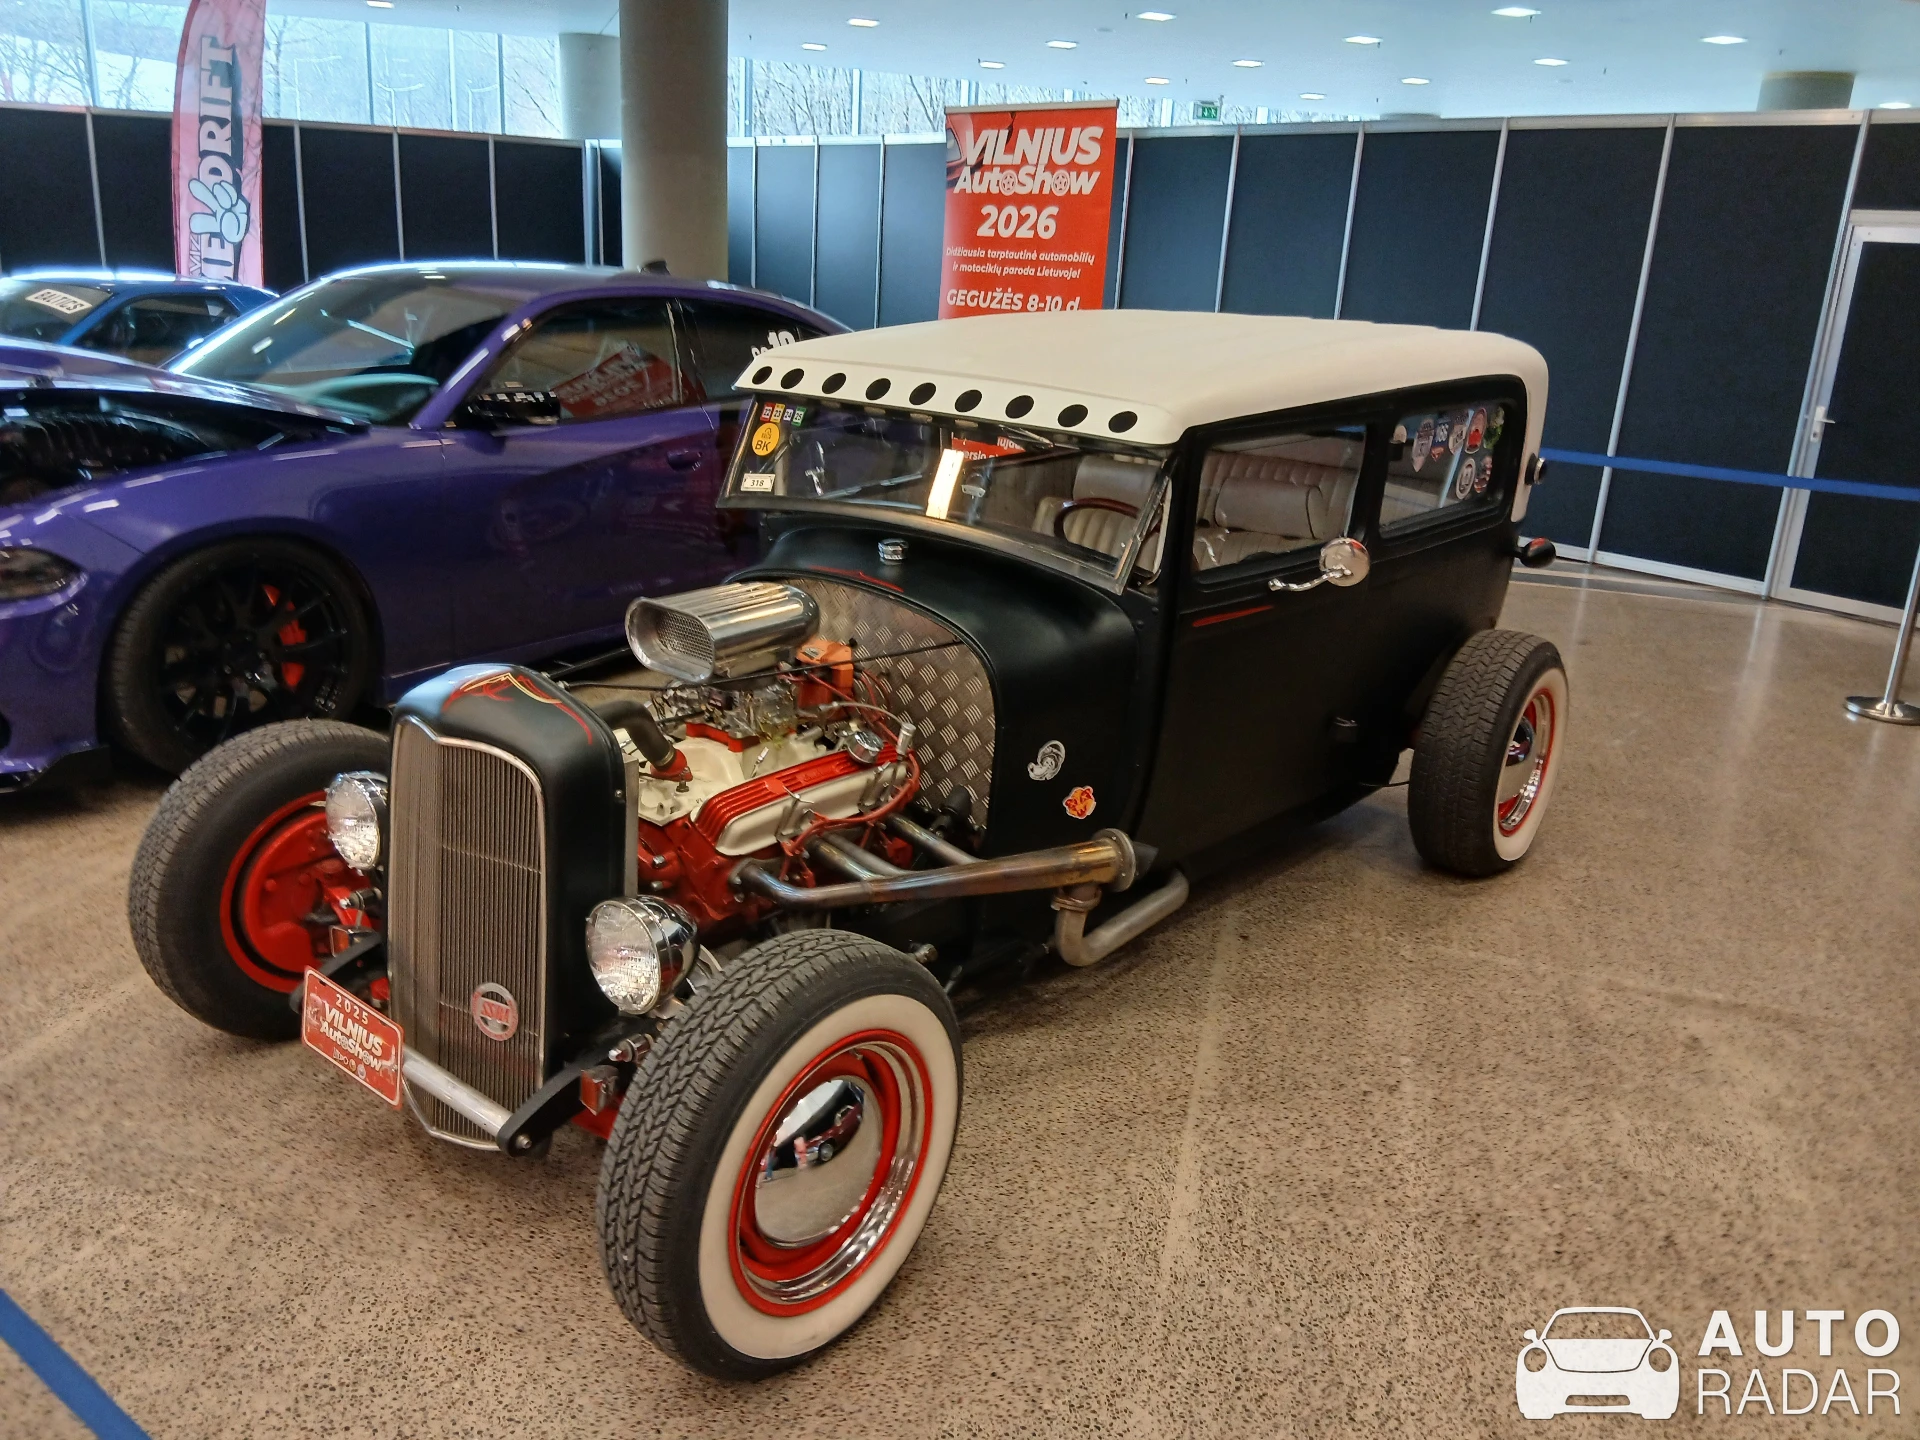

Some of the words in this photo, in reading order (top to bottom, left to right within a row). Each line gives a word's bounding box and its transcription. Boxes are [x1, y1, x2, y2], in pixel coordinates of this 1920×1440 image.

[199, 36, 236, 187] DRIFT
[965, 126, 1103, 166] VILNIUS
[953, 164, 1101, 196] AutoShow
[976, 204, 1060, 239] 2026
[946, 247, 986, 258] Didžiausia
[987, 249, 1037, 261] tarptautinė
[1039, 252, 1095, 265] automobilių
[952, 261, 959, 271] ir
[959, 262, 1001, 276] motociklų
[1002, 265, 1035, 276] paroda
[1037, 266, 1081, 280] Lietuvoje!
[946, 287, 1024, 311] GEGUŽĖS
[1026, 293, 1064, 312] 8-10
[755, 439, 771, 452] BK
[335, 993, 369, 1025] 2025
[322, 1000, 383, 1057] VILNIUS
[319, 1020, 383, 1072] AutoShow
